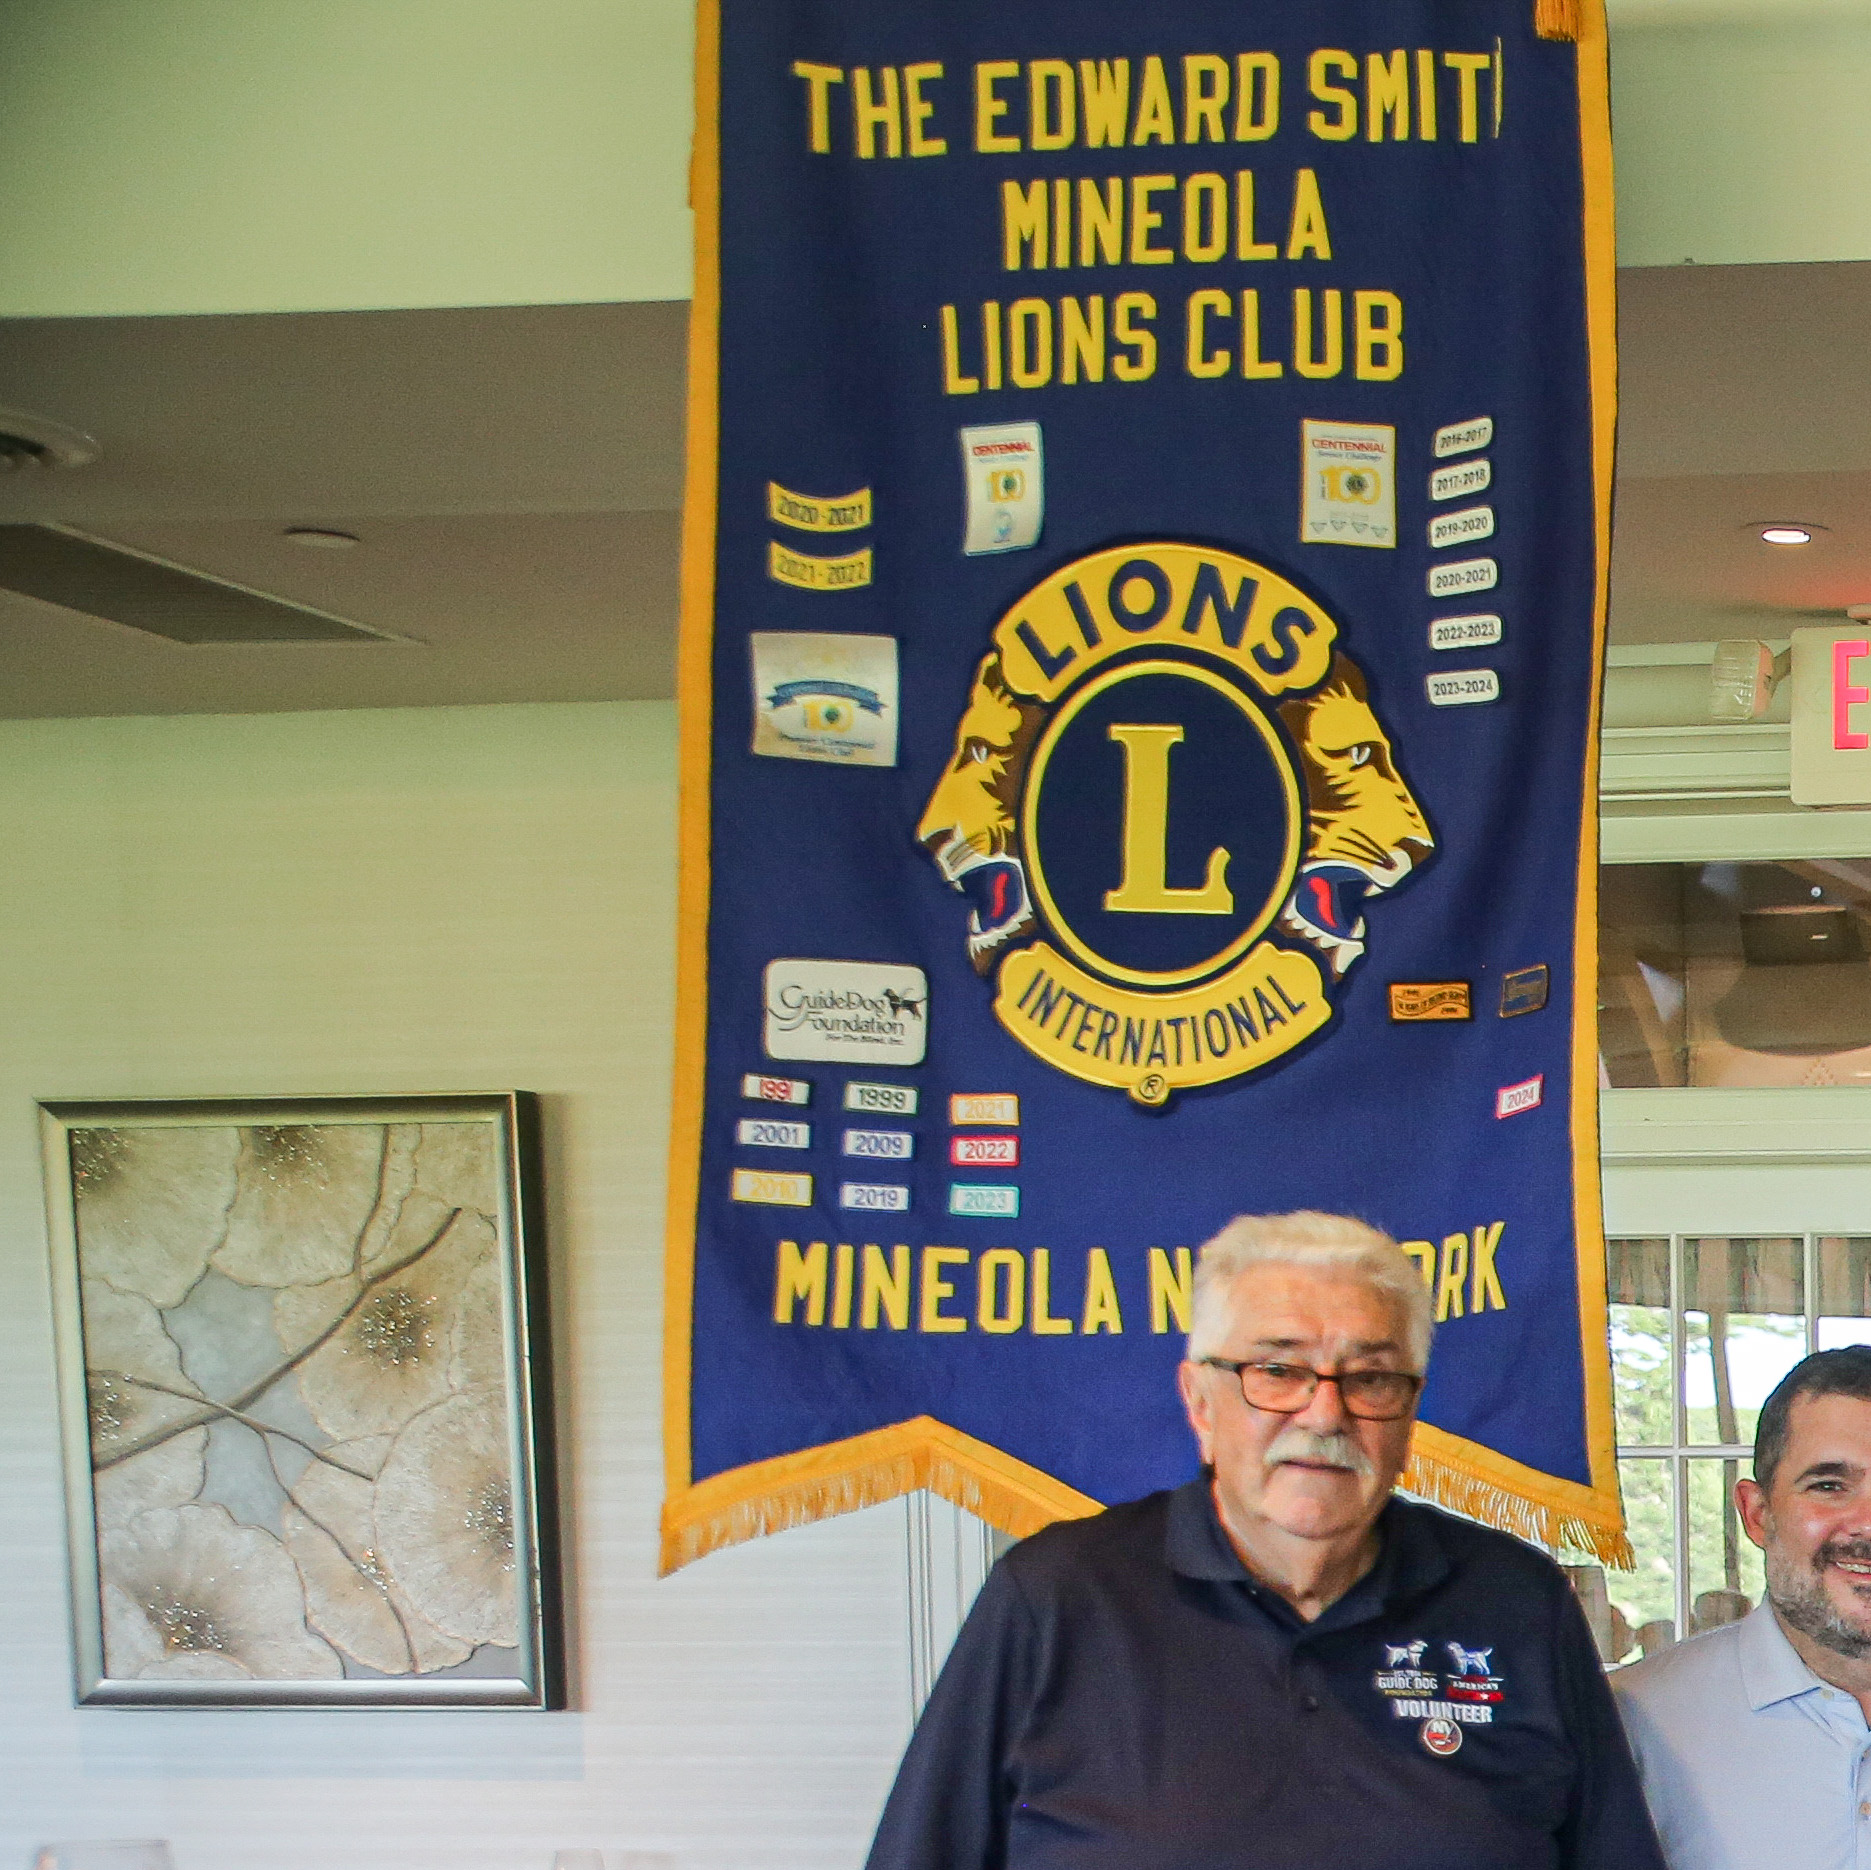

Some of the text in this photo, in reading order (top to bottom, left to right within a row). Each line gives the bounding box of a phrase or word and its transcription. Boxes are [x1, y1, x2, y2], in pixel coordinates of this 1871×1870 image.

[794, 40, 1502, 159] THE EDWARD SMIT
[1001, 169, 1332, 270] MINEOLA
[940, 289, 1403, 395] LIONS CLUB
[1311, 439, 1387, 454] CENTENNIAL
[1437, 468, 1486, 491] 2017-2018
[1435, 516, 1488, 539] 2019-2020
[1436, 567, 1492, 588] 2020-2021
[1015, 559, 1318, 683] LIONS
[1437, 623, 1495, 642] 2022-2023
[1434, 679, 1494, 696] 2023-2024
[1105, 723, 1234, 914] L
[800, 1011, 905, 1037] Foundation
[1016, 969, 1307, 1067] INTERNATIONAL
[858, 1087, 906, 1111] 1999
[1507, 1087, 1534, 1109] 2024
[965, 1100, 1007, 1120] 2021
[752, 1124, 799, 1146] 2001
[855, 1133, 902, 1155] 2009
[965, 1141, 1008, 1160] 2022
[855, 1187, 898, 1208] 2019
[773, 1240, 1123, 1334] MINEOLA
[1400, 1221, 1506, 1323] RK
[1378, 1677, 1438, 1690] GUIDE DOG
[1396, 1699, 1493, 1723] VOLUNTEER
